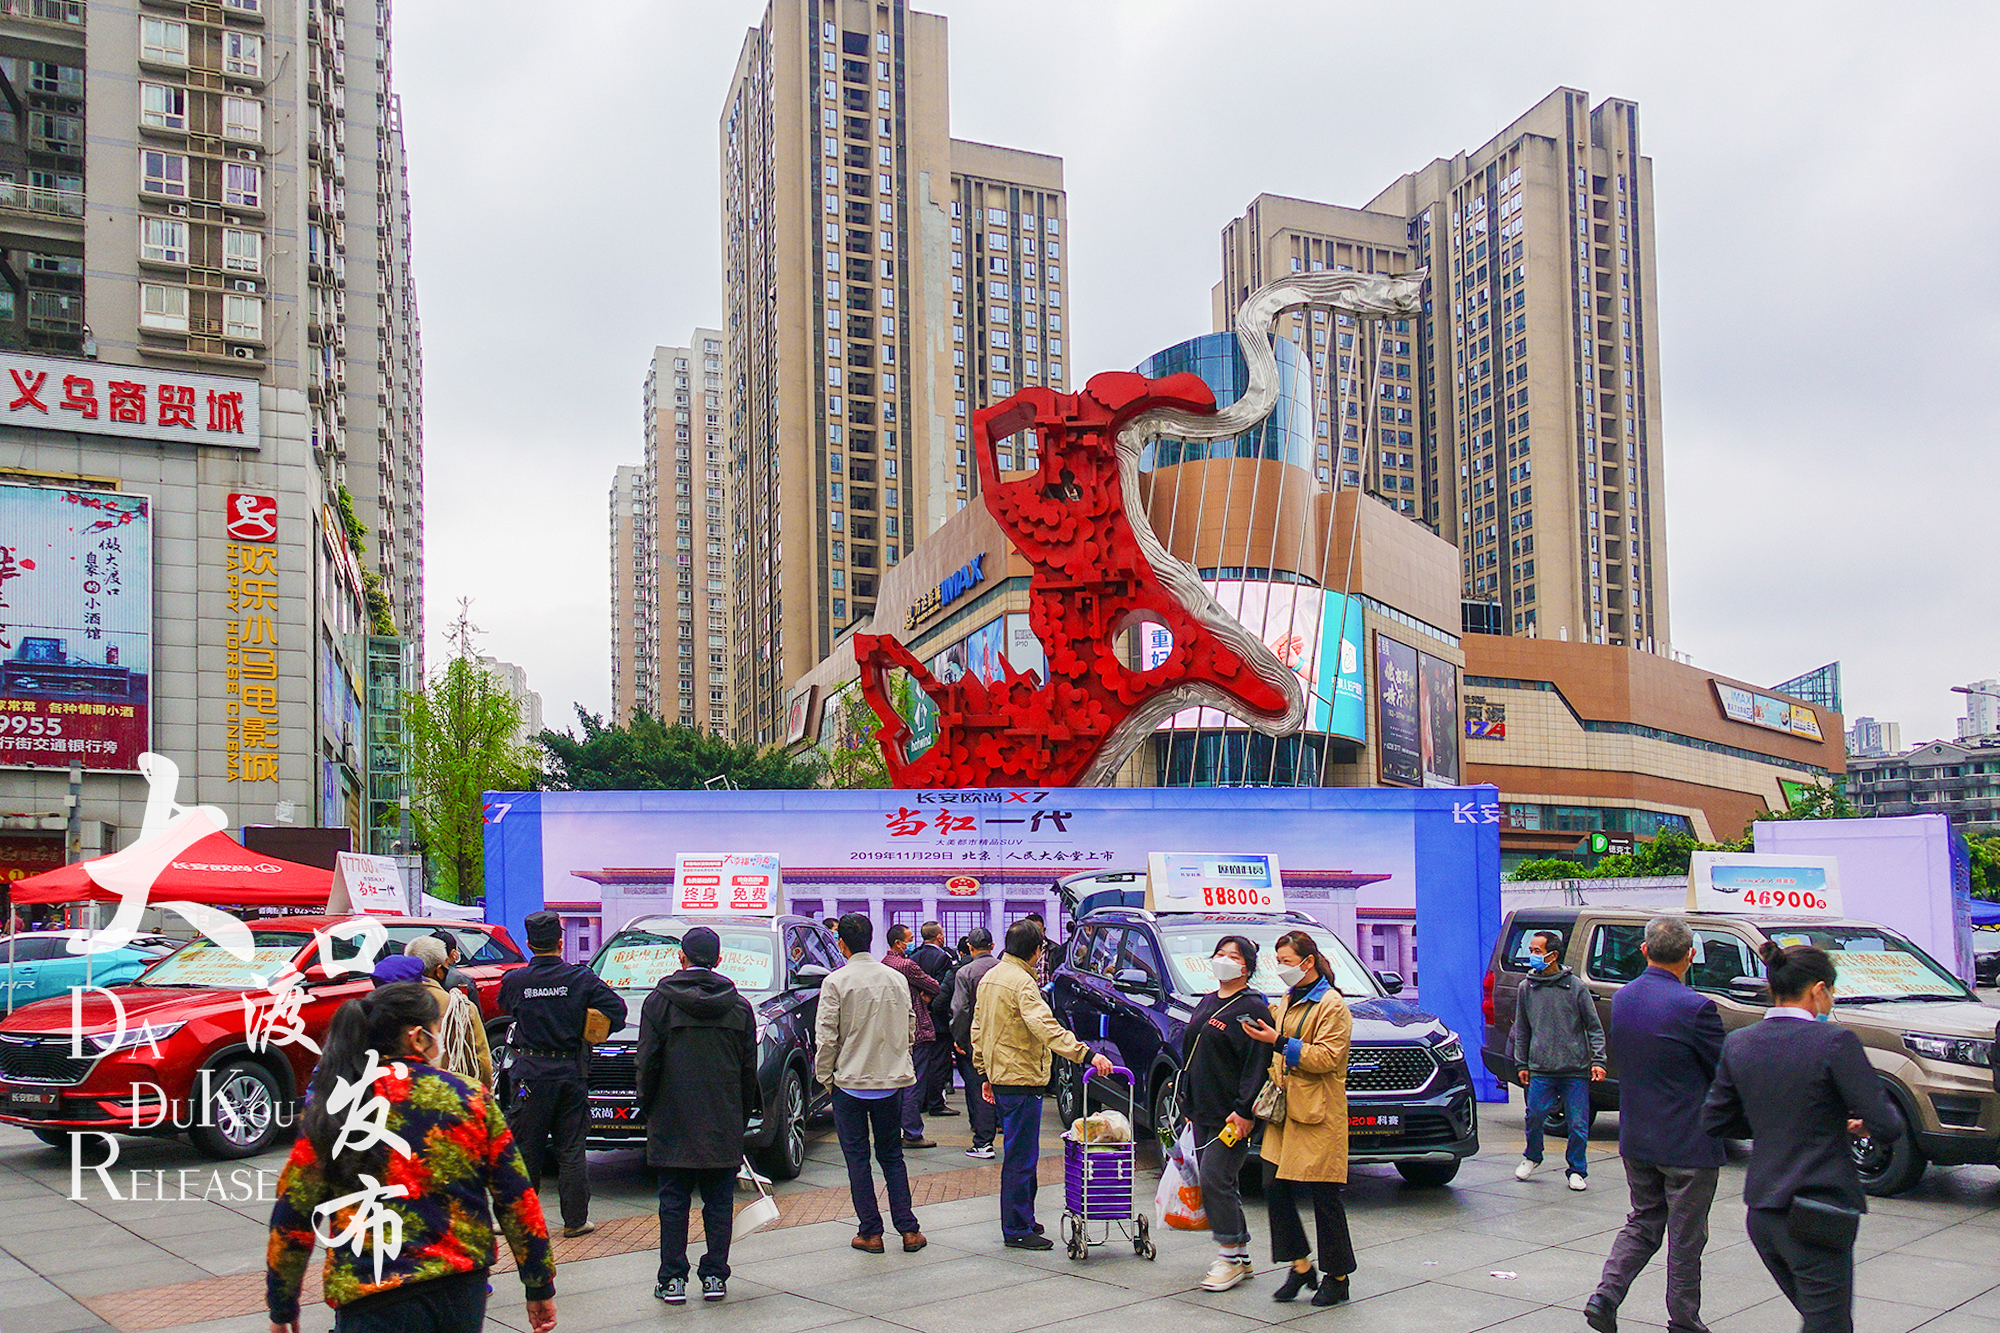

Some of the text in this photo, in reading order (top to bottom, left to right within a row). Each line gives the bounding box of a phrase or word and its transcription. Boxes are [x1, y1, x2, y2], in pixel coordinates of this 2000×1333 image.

[9, 368, 245, 434] 义乌商贸城
[940, 551, 985, 606] IMAX
[226, 543, 239, 782] HAPPY HORSE CINEMA
[241, 544, 279, 783] 欢乐小马电影城
[48, 702, 134, 718] 各种情调小酒
[0, 736, 118, 754] 行街交通银行旁
[916, 791, 1050, 804] 长安欧尚X7
[885, 806, 1073, 837] 当红一代
[935, 838, 1024, 846] 大美都市精品SUV
[1608, 845, 1632, 854] 德克士
[850, 851, 953, 861] 2019年11月29日
[342, 856, 378, 874] 77700
[684, 887, 766, 901] 终身 免费
[1208, 1018, 1227, 1031] CUTE
[590, 1107, 641, 1120] 欧尚X7
